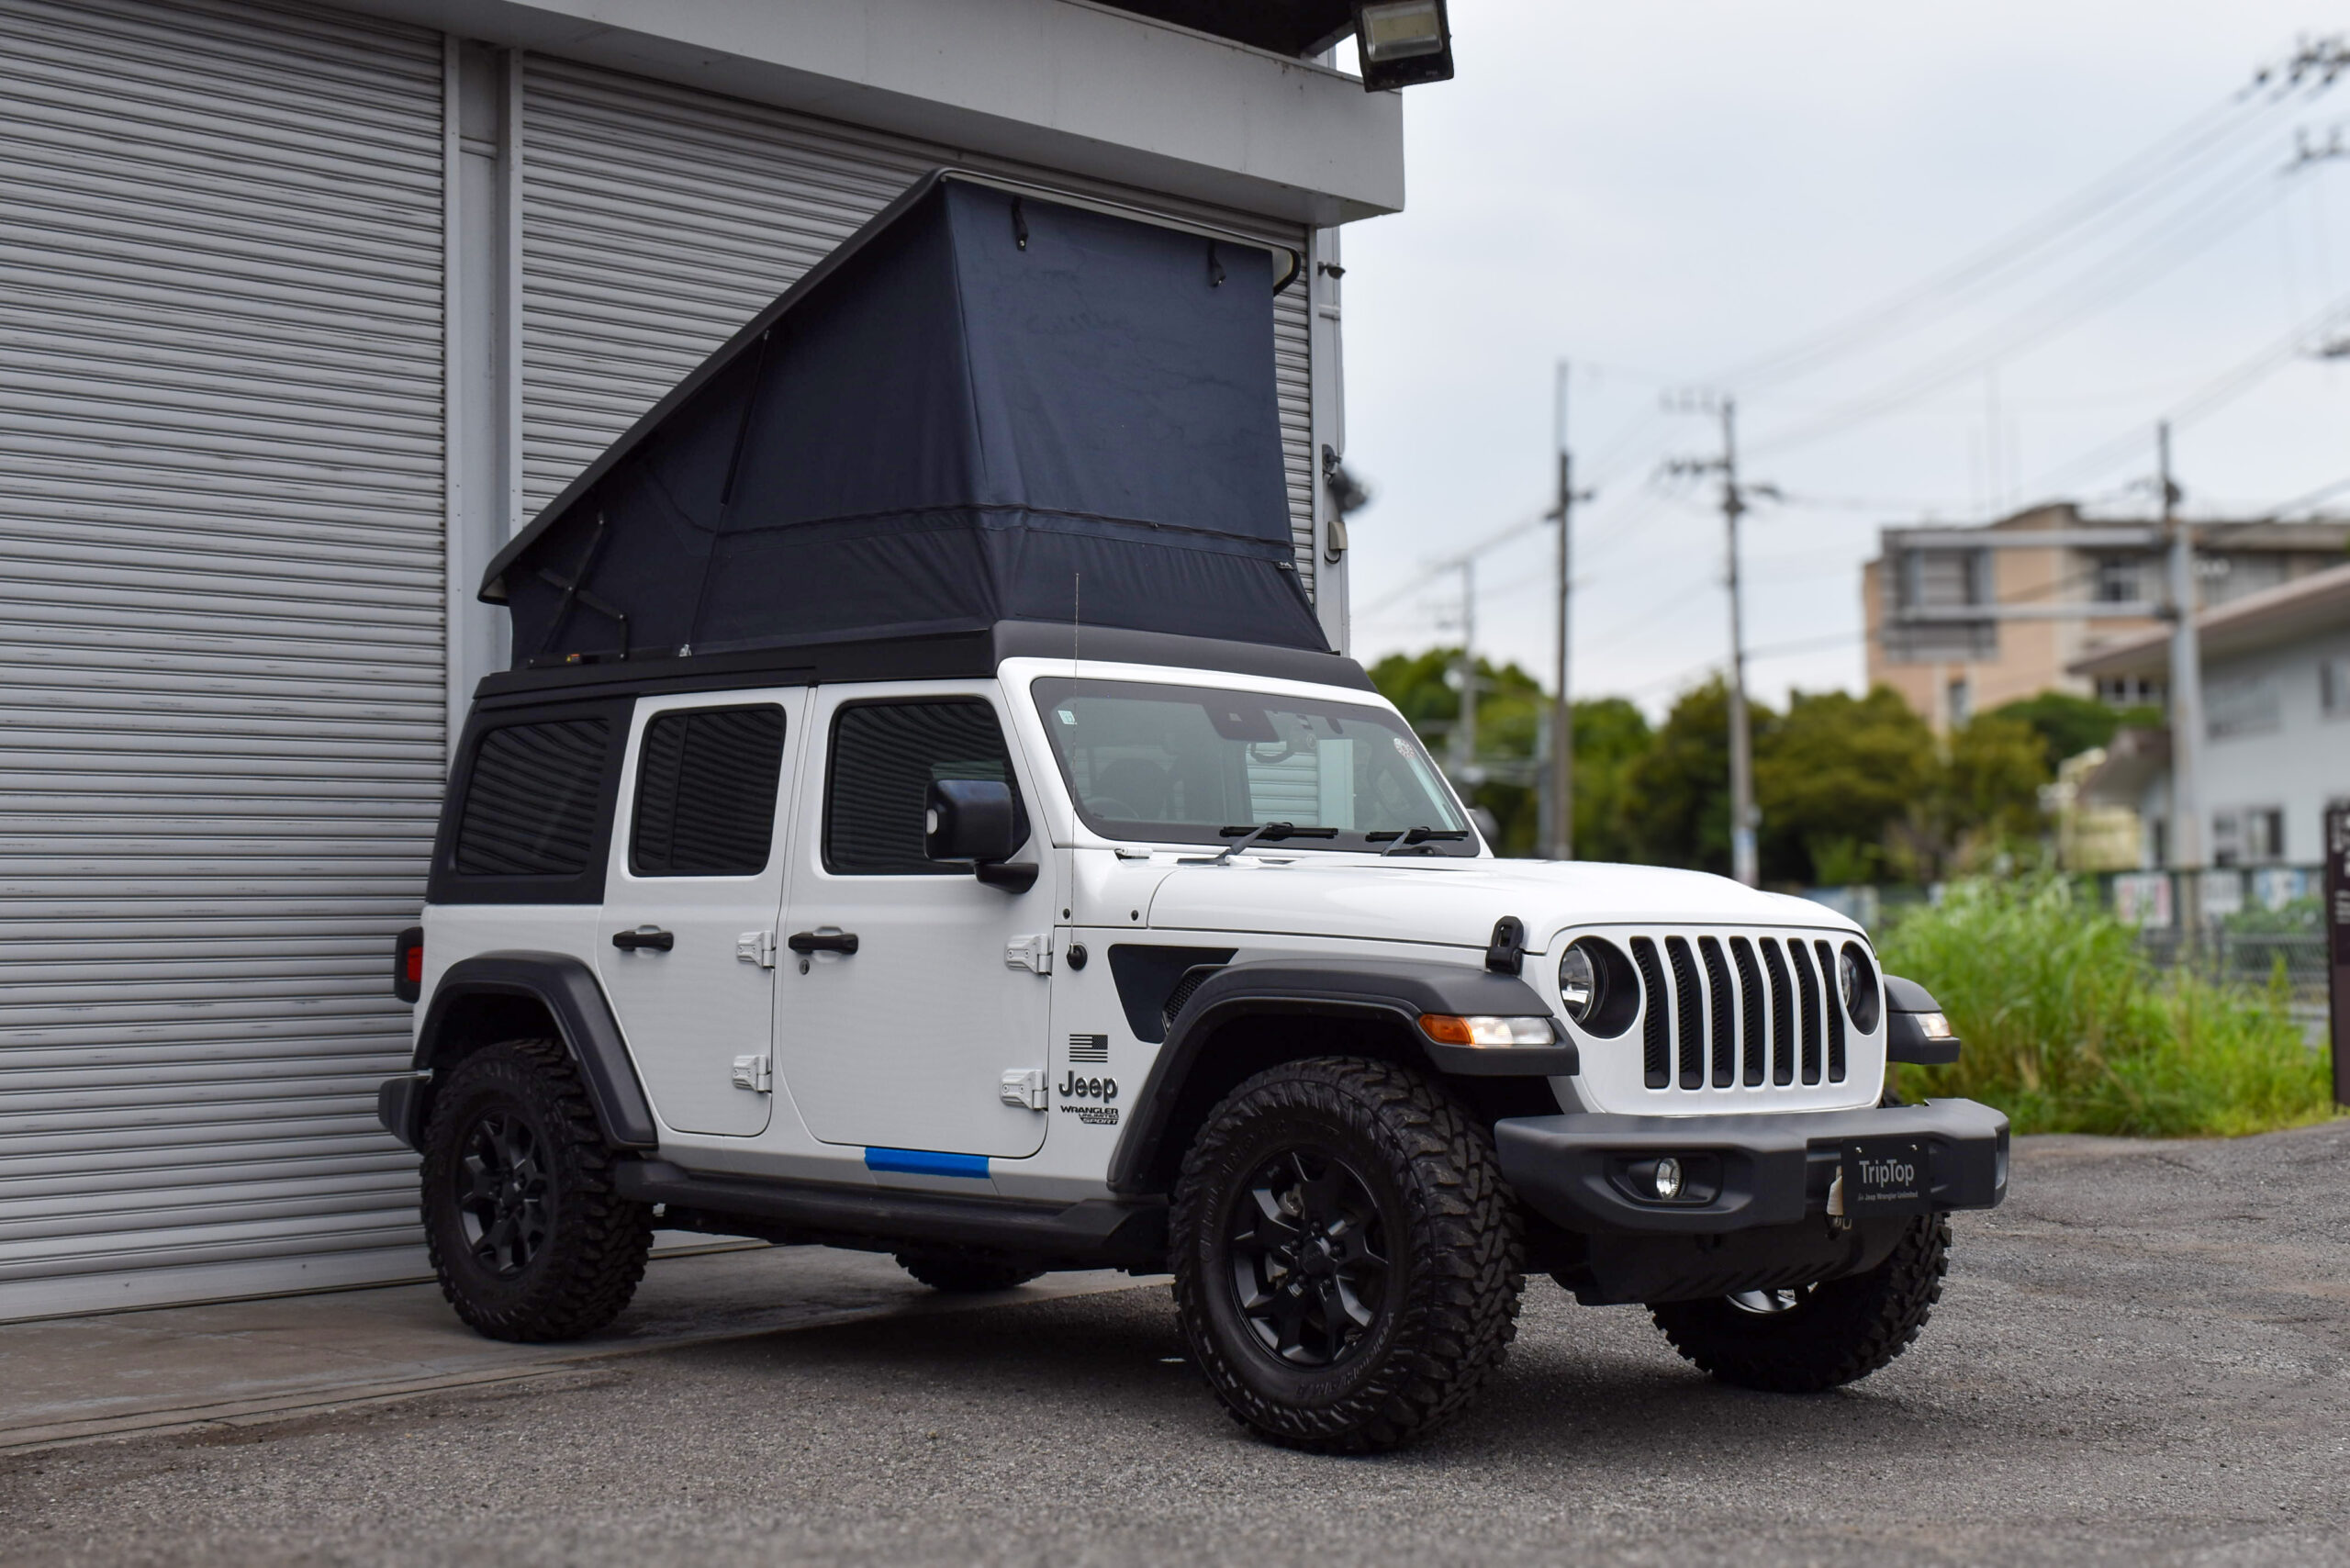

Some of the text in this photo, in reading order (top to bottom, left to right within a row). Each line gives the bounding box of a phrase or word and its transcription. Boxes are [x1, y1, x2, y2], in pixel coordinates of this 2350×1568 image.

[1058, 1070, 1118, 1103] Jeep
[1060, 1105, 1118, 1114] WRANGLER
[1858, 1159, 1915, 1188] TripTop
